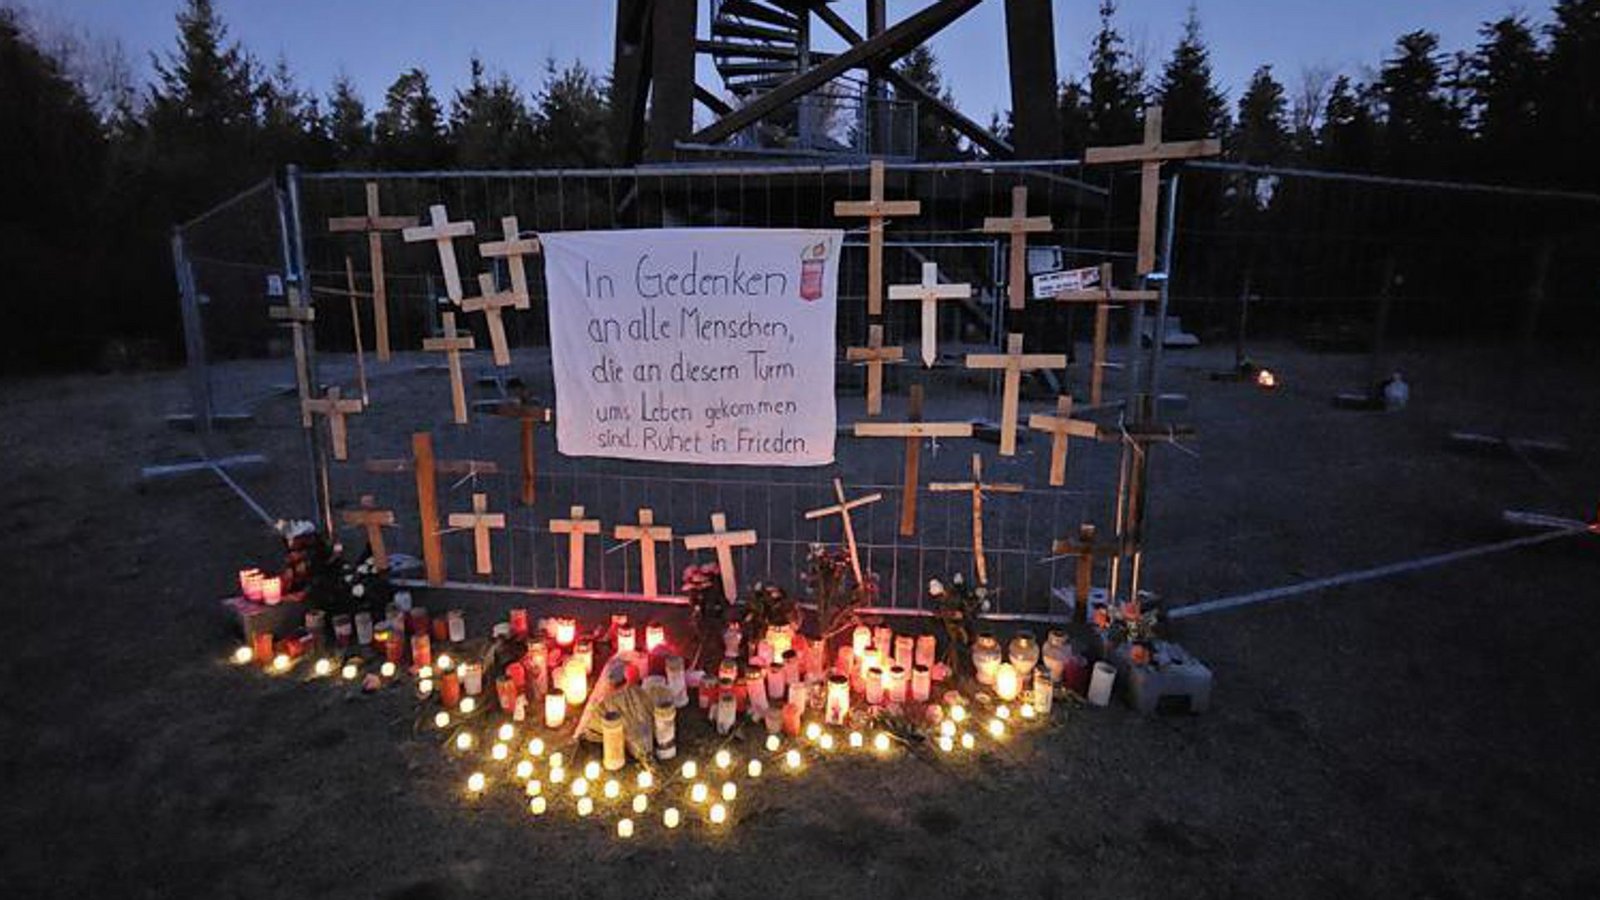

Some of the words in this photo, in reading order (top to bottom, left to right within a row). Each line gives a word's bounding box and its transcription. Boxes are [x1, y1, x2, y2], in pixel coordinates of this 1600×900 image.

[585, 260, 614, 298] In
[636, 250, 787, 298] Gedenken
[588, 316, 620, 342] an
[628, 306, 670, 342] alle
[680, 306, 794, 343] Menschen,
[592, 356, 623, 383] die
[633, 362, 661, 381] an
[671, 351, 739, 382] diesem
[748, 350, 794, 380] Turm
[596, 406, 630, 422] ums
[641, 391, 692, 422] Leben
[705, 400, 796, 428] gekommen
[598, 429, 638, 448] sind.
[712, 433, 726, 452] in
[737, 428, 809, 454] Frieden.
